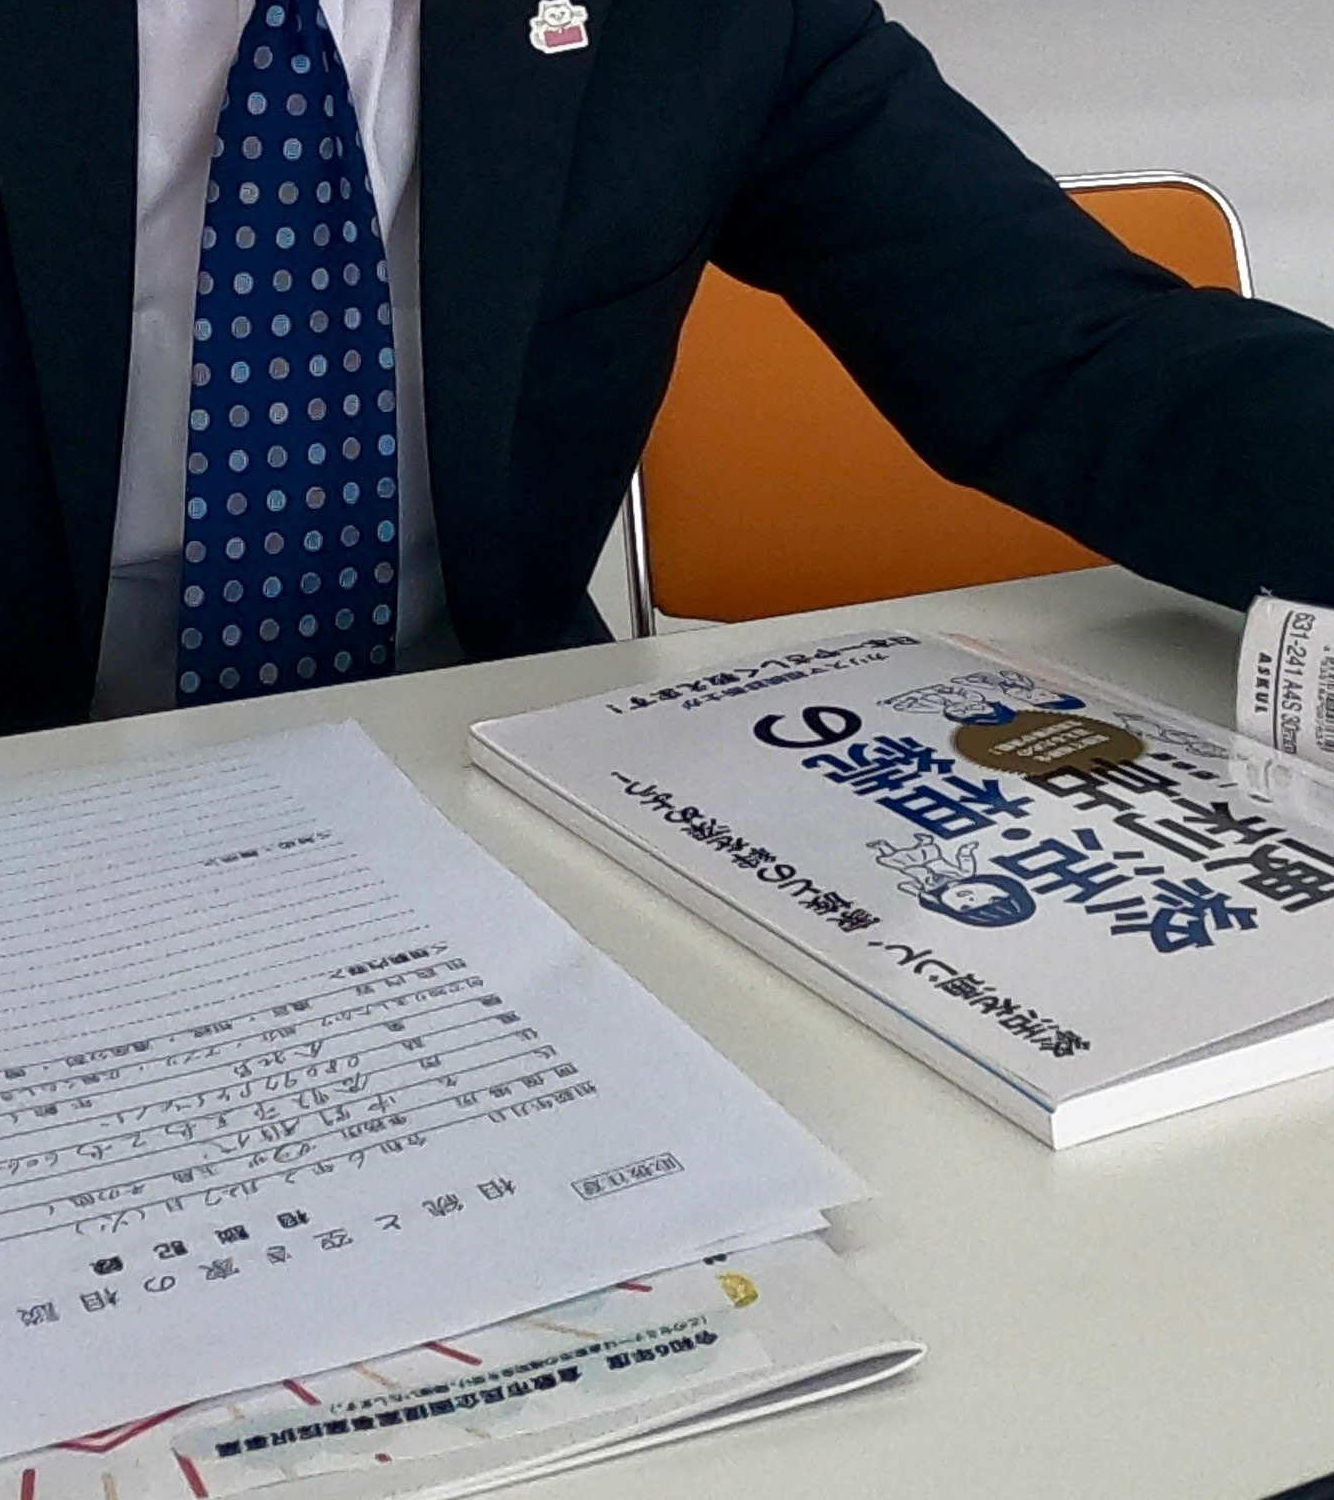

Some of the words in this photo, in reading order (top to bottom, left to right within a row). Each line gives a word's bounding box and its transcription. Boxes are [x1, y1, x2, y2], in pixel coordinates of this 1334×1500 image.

[1284, 611, 1316, 677] 631-241
[1253, 651, 1273, 714] ASKUL
[1281, 678, 1304, 713] A4S
